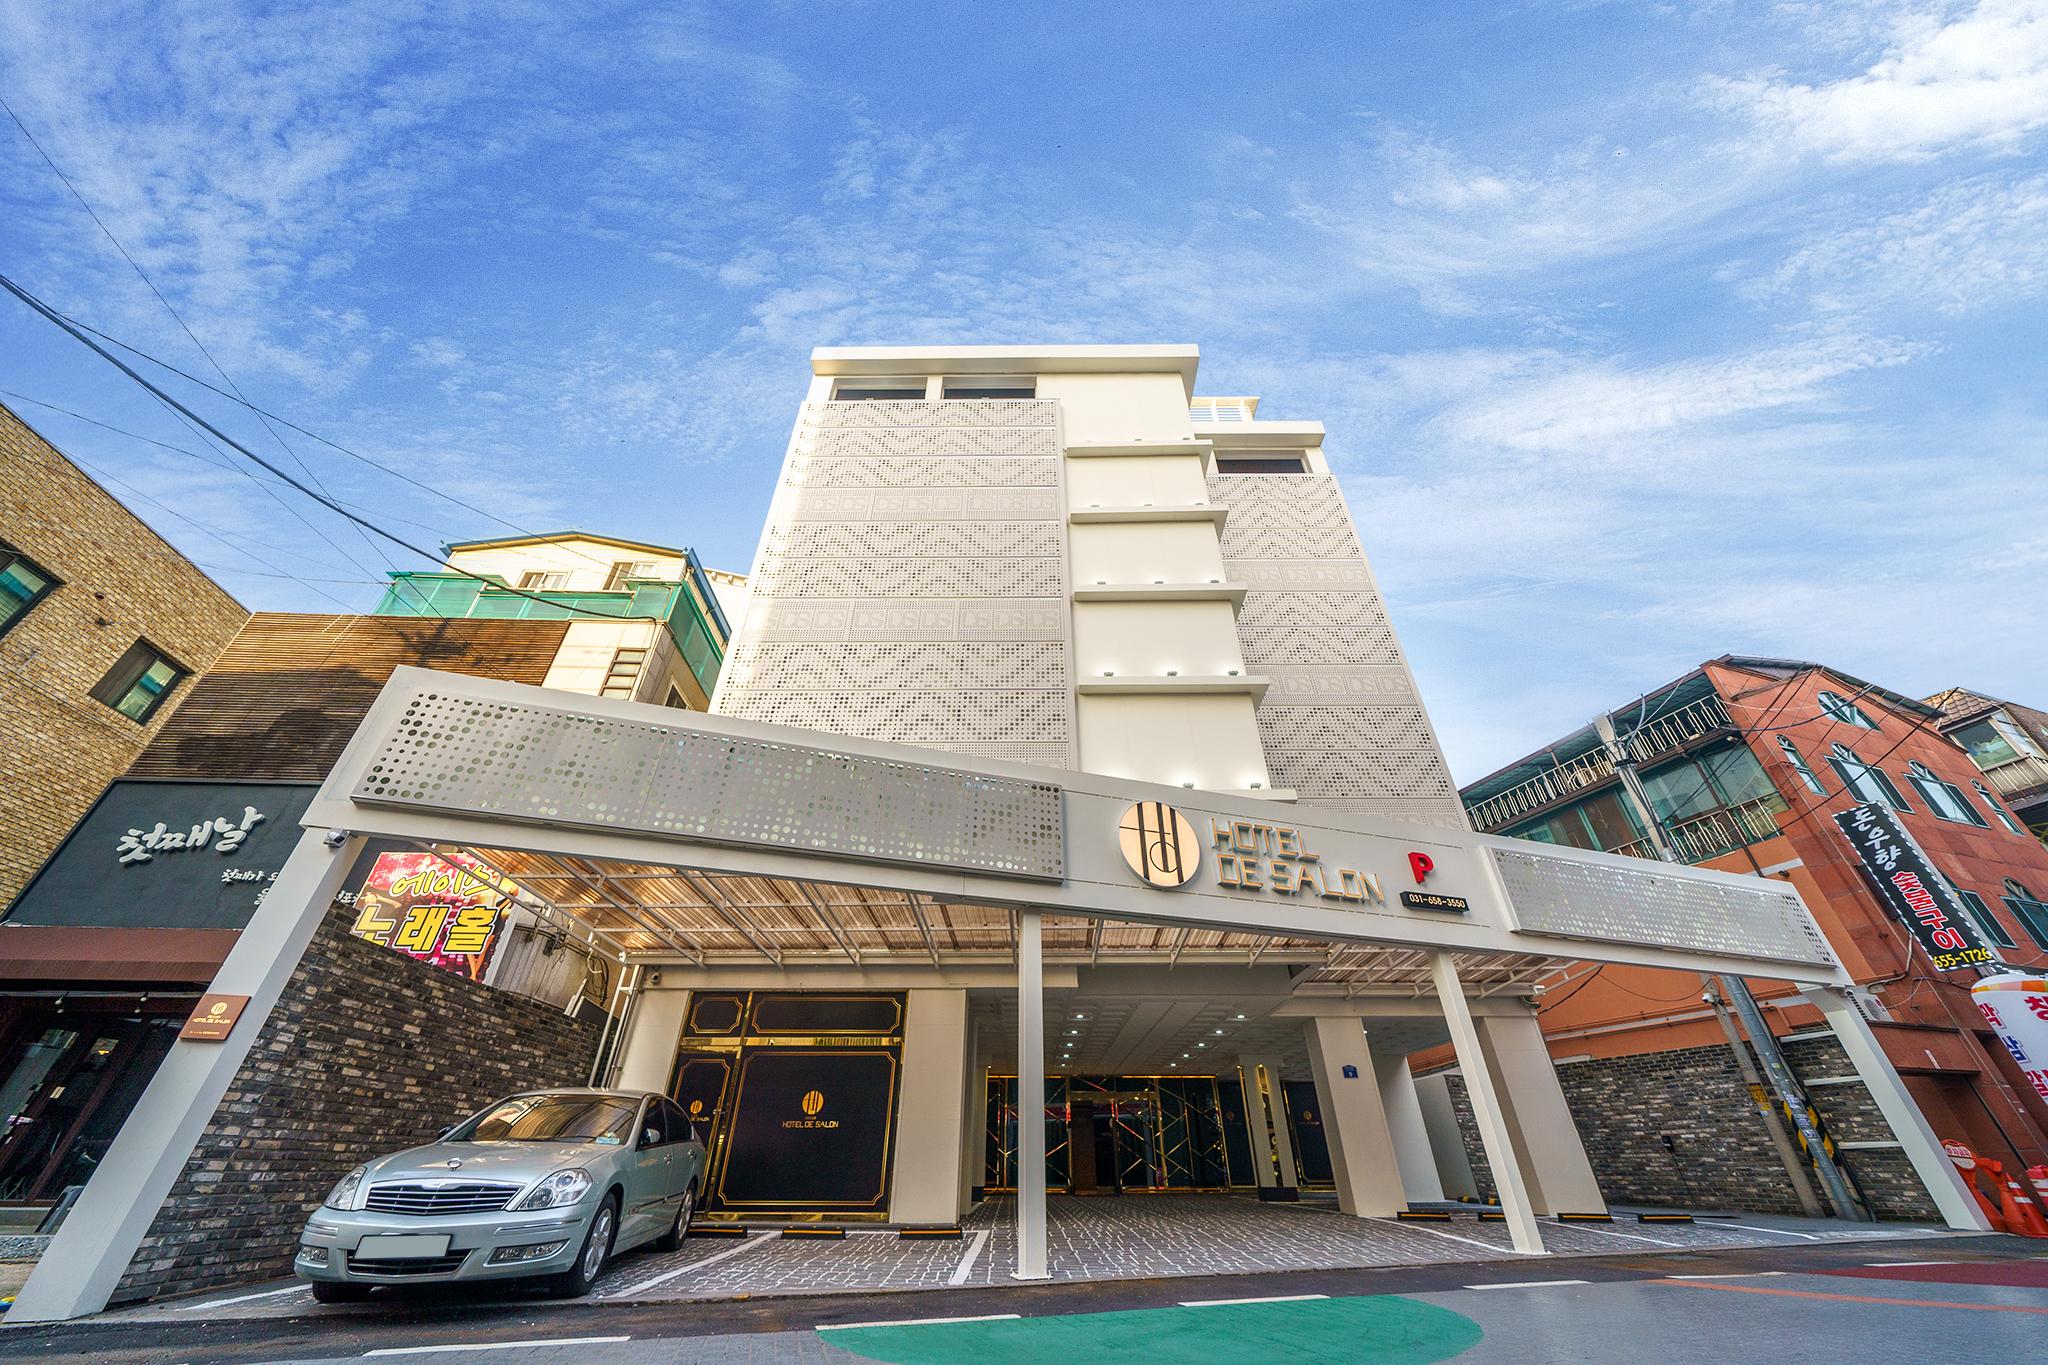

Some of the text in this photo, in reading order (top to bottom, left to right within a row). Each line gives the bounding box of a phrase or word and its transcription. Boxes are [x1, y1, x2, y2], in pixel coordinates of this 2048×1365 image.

[1209, 817, 1320, 862] HOTEL
[391, 864, 491, 897] 에이스
[1216, 853, 1385, 903] DE SALON
[1407, 851, 1434, 885] P
[1408, 893, 1466, 908] 031-658-3550
[354, 904, 499, 953] 노래홀
[1933, 947, 1992, 968] 655-1726
[781, 1120, 840, 1128] HOTEL DE SALON
